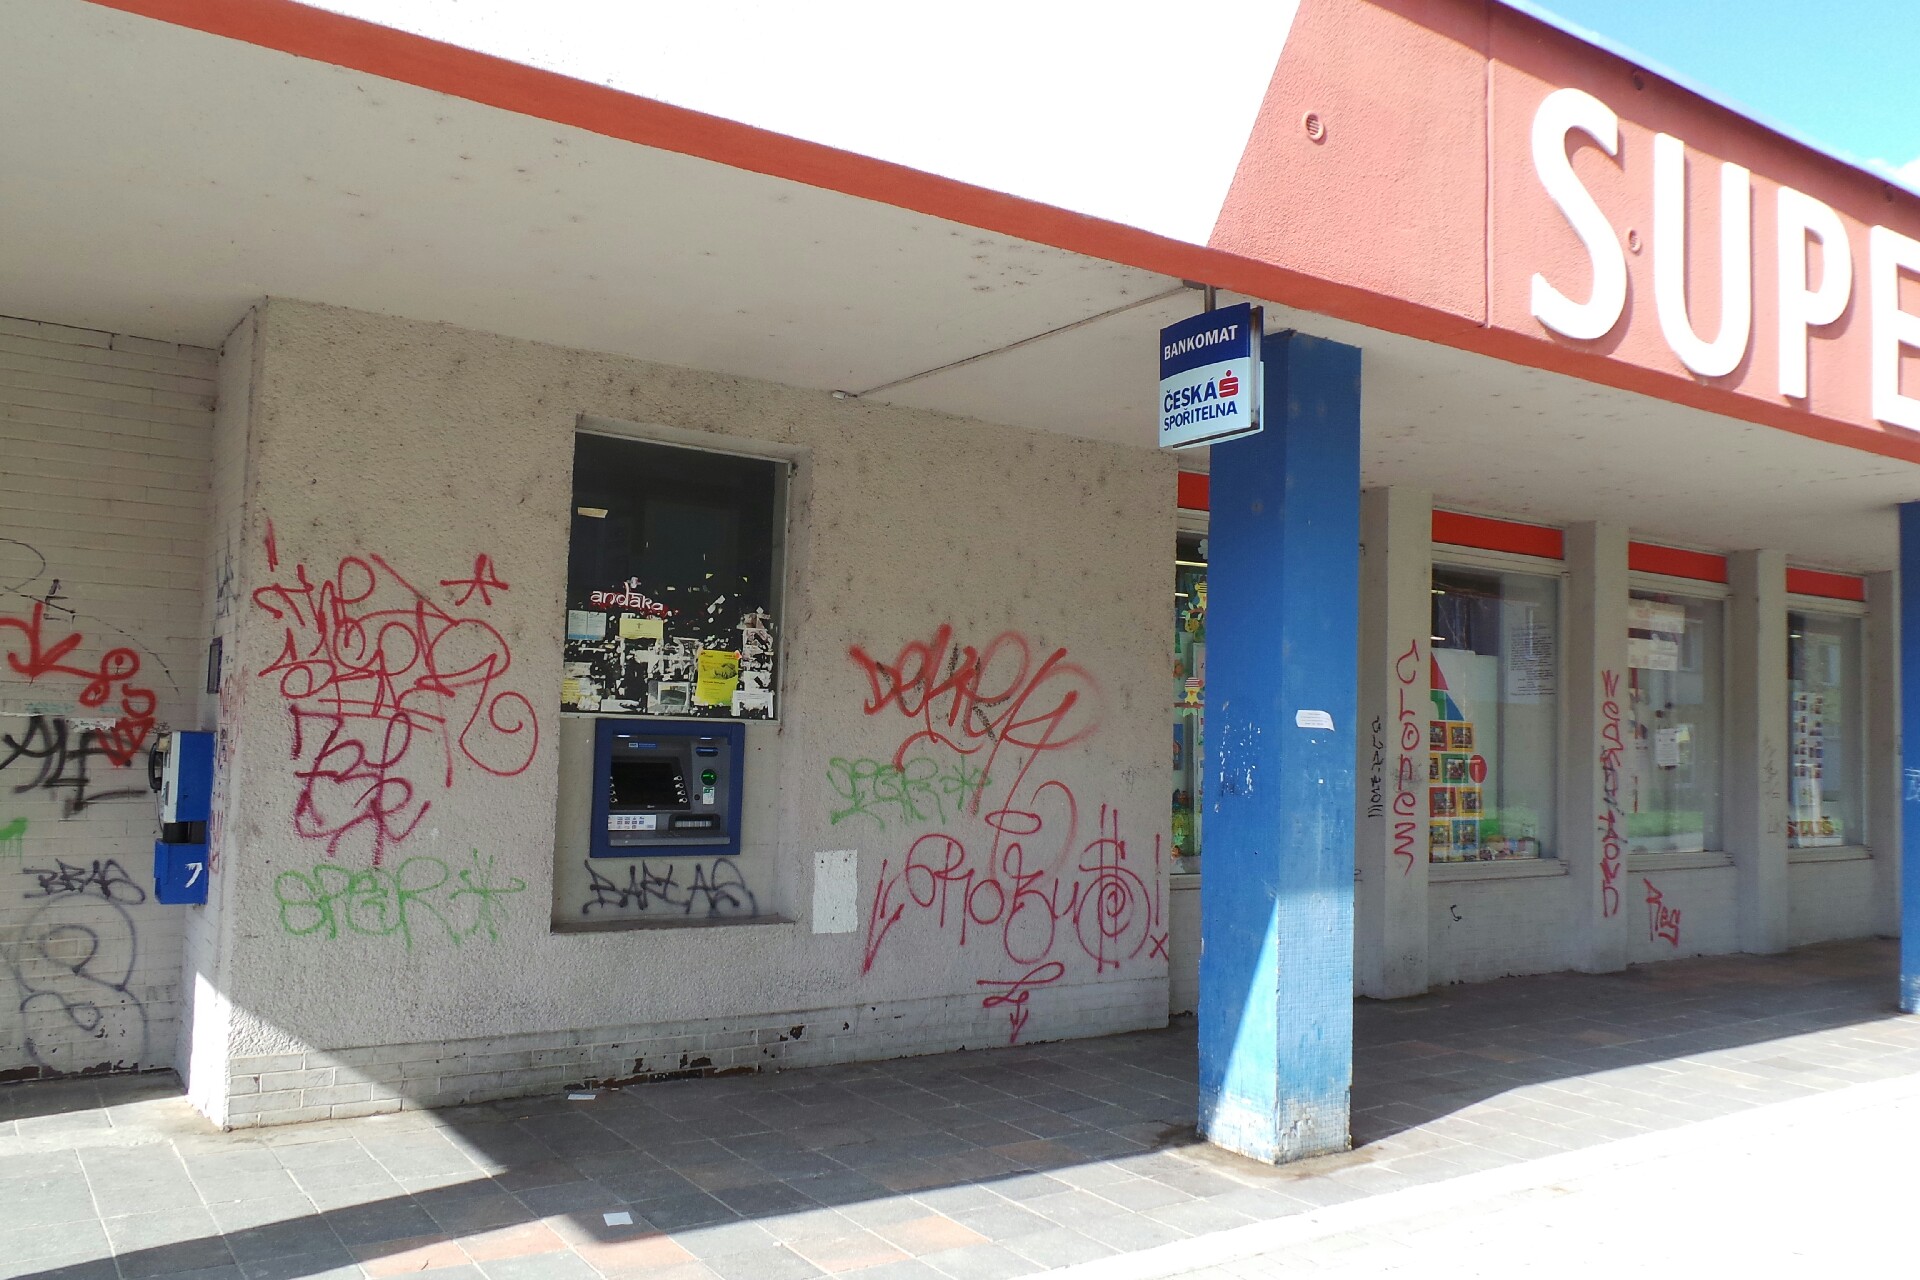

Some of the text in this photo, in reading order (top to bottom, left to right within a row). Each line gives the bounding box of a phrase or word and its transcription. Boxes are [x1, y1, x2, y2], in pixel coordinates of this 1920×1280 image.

[1531, 88, 1920, 432] SUPE
[1164, 325, 1239, 361] BANKOMAT
[1164, 377, 1218, 413] ČESKÁ
[1164, 401, 1238, 431] SPOŘITELNA
